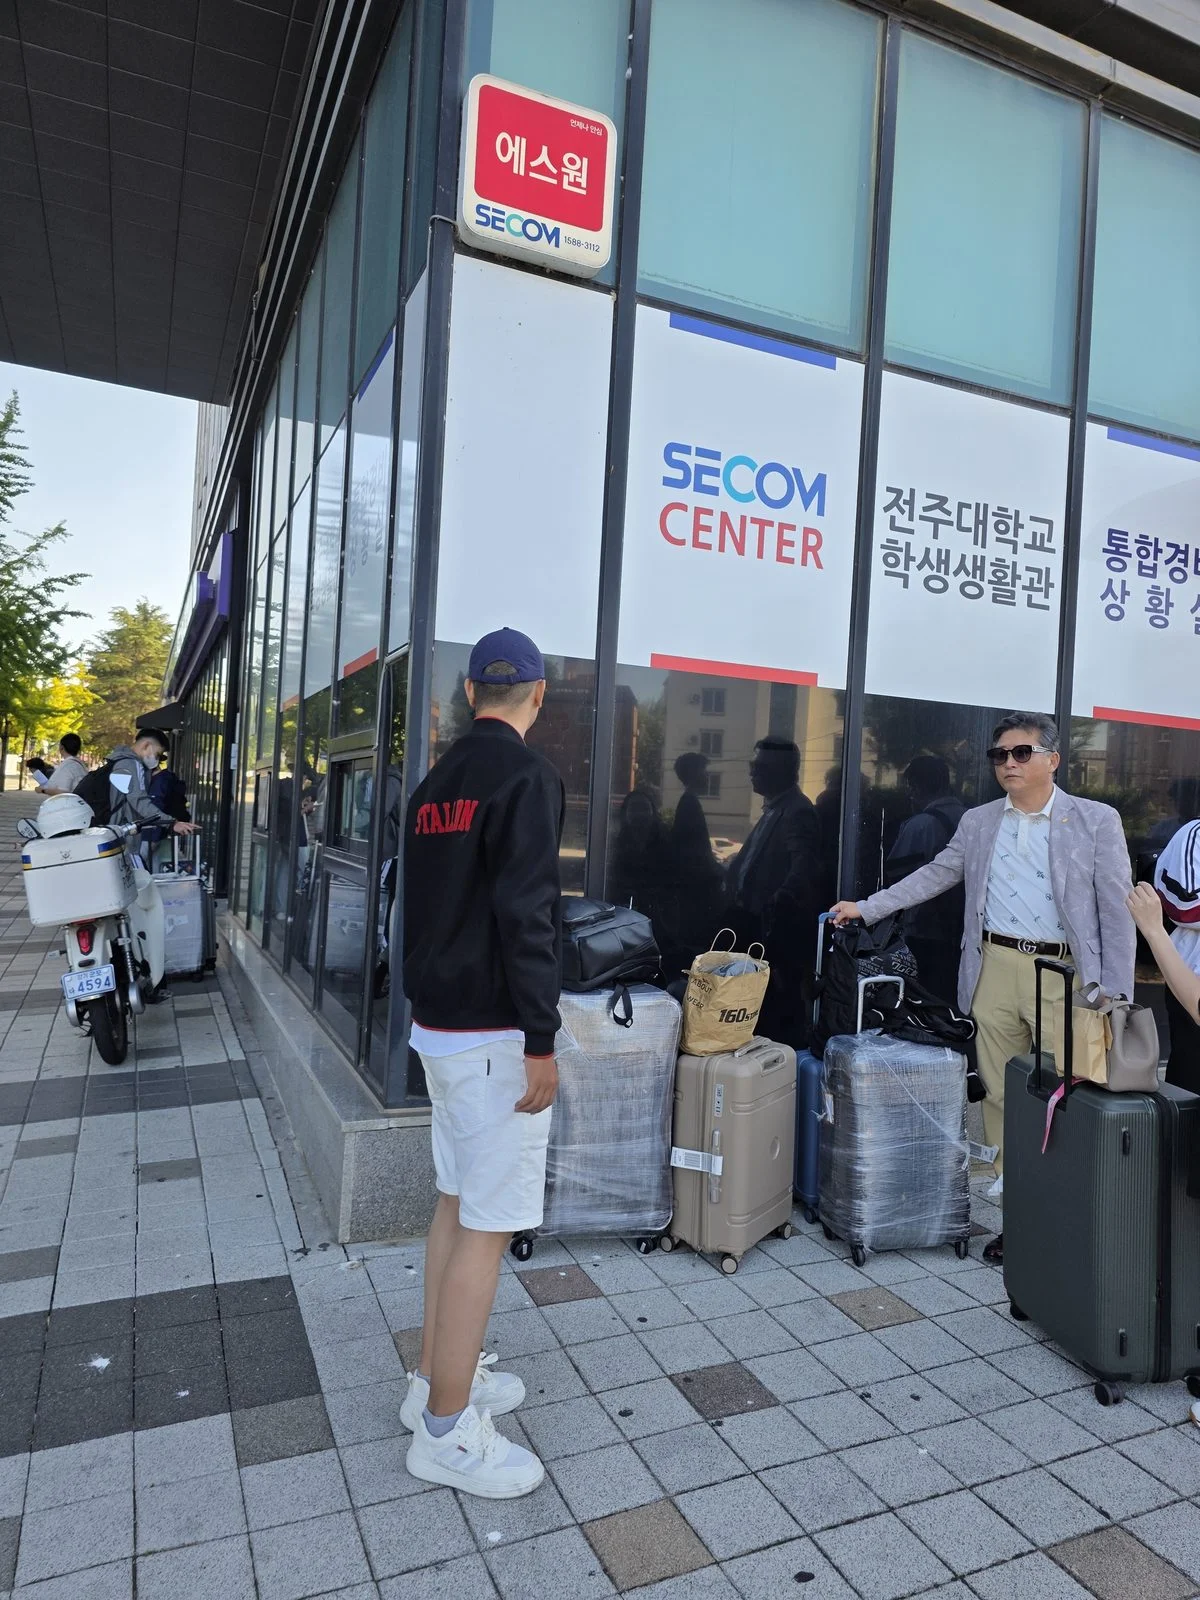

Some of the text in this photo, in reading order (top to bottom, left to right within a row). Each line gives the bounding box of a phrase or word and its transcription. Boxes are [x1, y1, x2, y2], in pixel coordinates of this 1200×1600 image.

[570, 118, 603, 136] 언제나 안심
[495, 131, 589, 196] 에스원
[475, 203, 600, 253] SECOM 1588-3112
[662, 441, 828, 518] SECOM
[658, 501, 825, 571] CENTER
[881, 485, 1057, 556] 전주대학교
[879, 537, 1056, 613] 학생생활관
[78, 975, 111, 993] 4594
[686, 995, 705, 1010] WEAR
[690, 978, 713, 994] ABOUT
